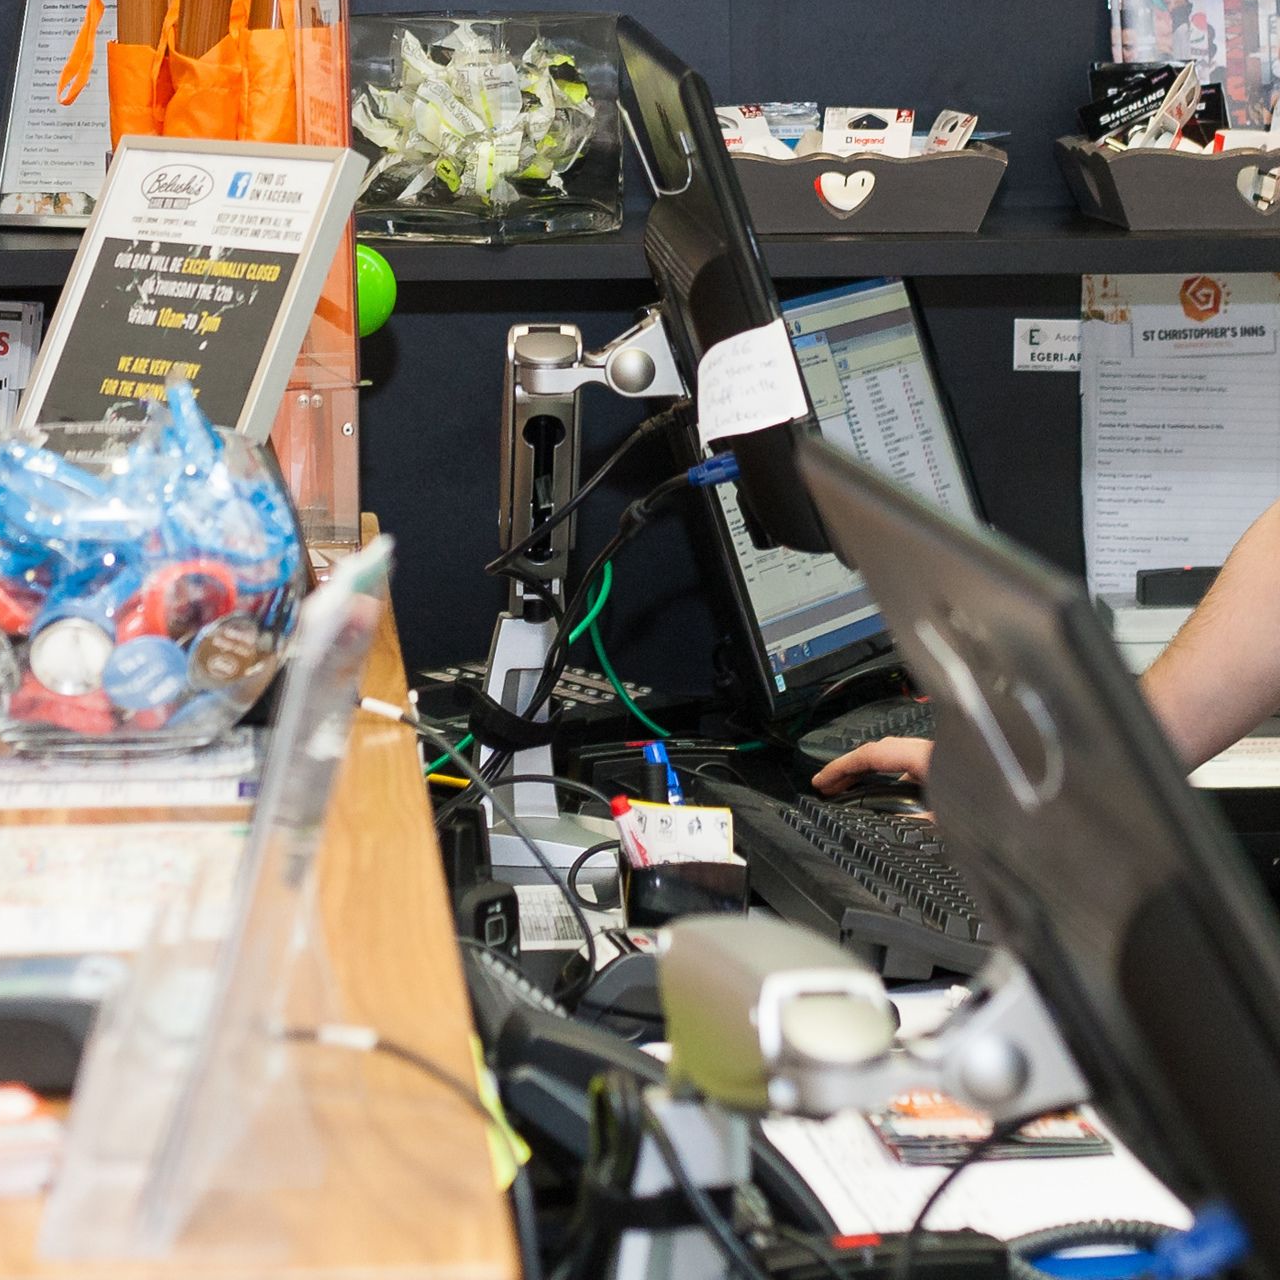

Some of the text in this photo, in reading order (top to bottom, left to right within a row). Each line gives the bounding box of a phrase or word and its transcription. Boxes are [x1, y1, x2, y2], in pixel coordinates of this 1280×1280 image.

[1099, 88, 1166, 126] SHENLING
[854, 136, 886, 146] legrand
[147, 172, 287, 196] Belushi's FIND US
[249, 190, 302, 204] ON FACEBOOK
[114, 252, 132, 269] OUR
[132, 253, 151, 270] BAR
[150, 254, 171, 272] WILL
[181, 257, 246, 279] EXCEPTIONALLY
[245, 263, 281, 282] CLOSED
[155, 279, 197, 300] THURSDAY
[195, 284, 215, 300] THE
[1028, 328, 1041, 346] E
[1142, 325, 1266, 342] ST CHRISTOPHER'S INNS
[117, 355, 173, 377] WE ARE VERY
[99, 378, 135, 397] FOR THE
